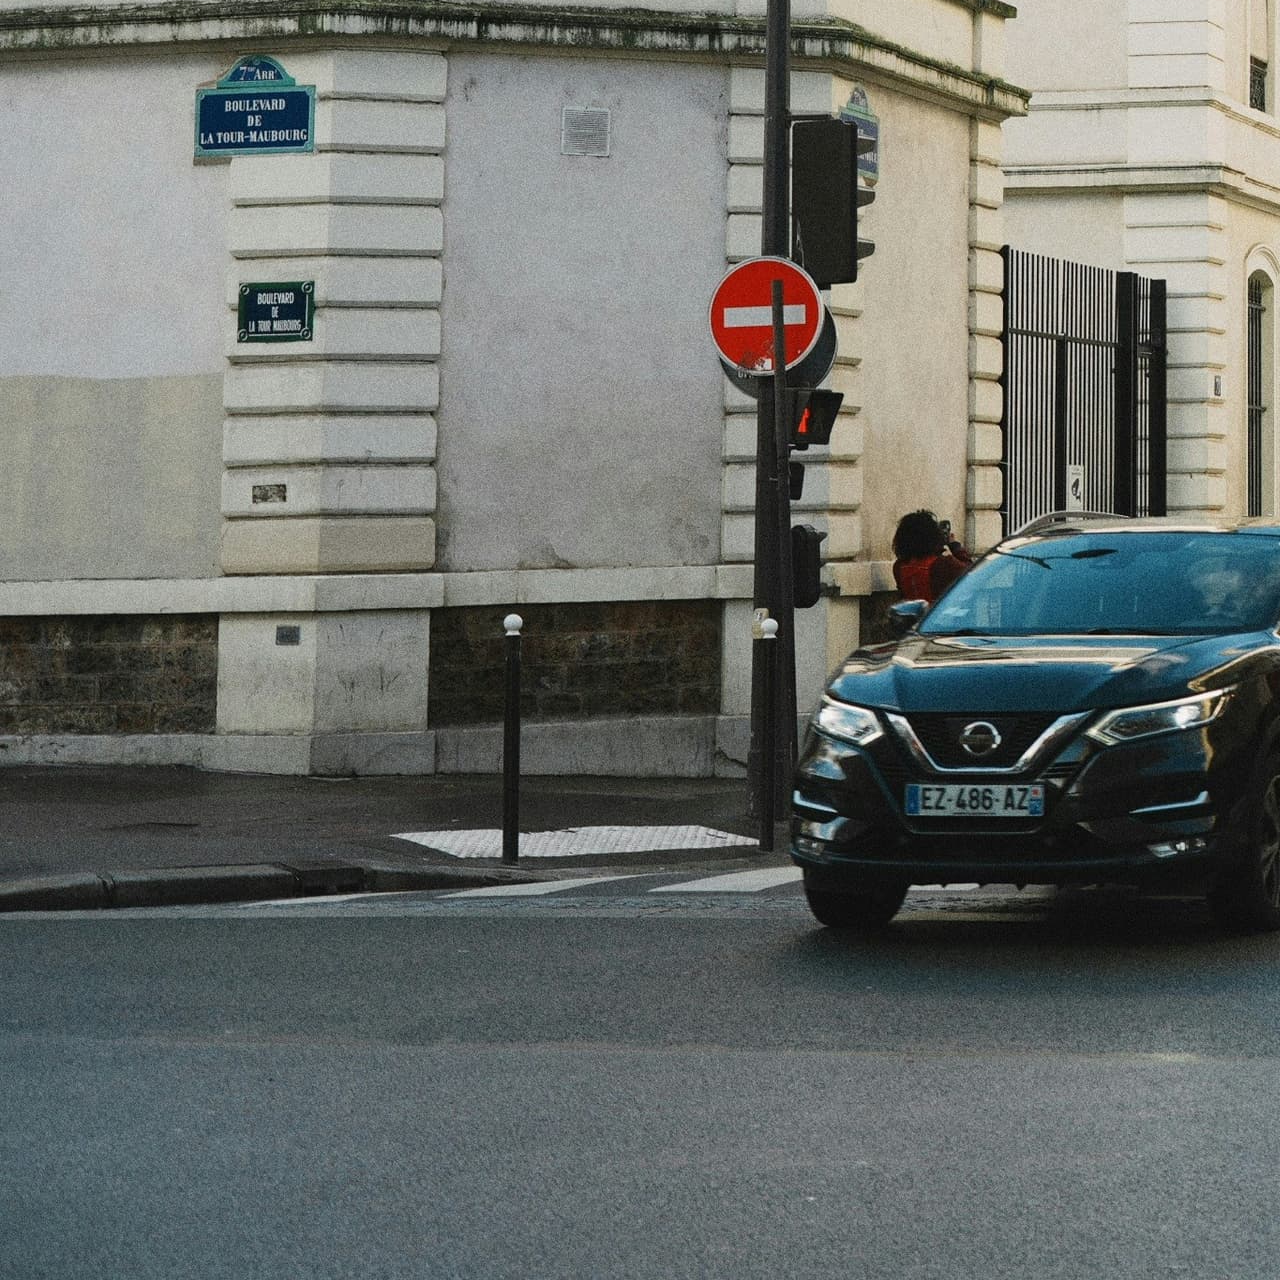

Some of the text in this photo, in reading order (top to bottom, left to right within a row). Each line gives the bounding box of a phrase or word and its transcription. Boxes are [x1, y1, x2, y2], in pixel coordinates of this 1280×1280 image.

[224, 98, 286, 112] BOULEVARD
[246, 115, 262, 127] DE
[200, 128, 308, 145] LA TOUR-MAUBOURG
[257, 292, 295, 305] BOULEVARD
[271, 306, 279, 318] DE
[248, 320, 256, 333] LA
[257, 319, 271, 333] TOUR
[921, 787, 1030, 810] EZ-486-AZ
